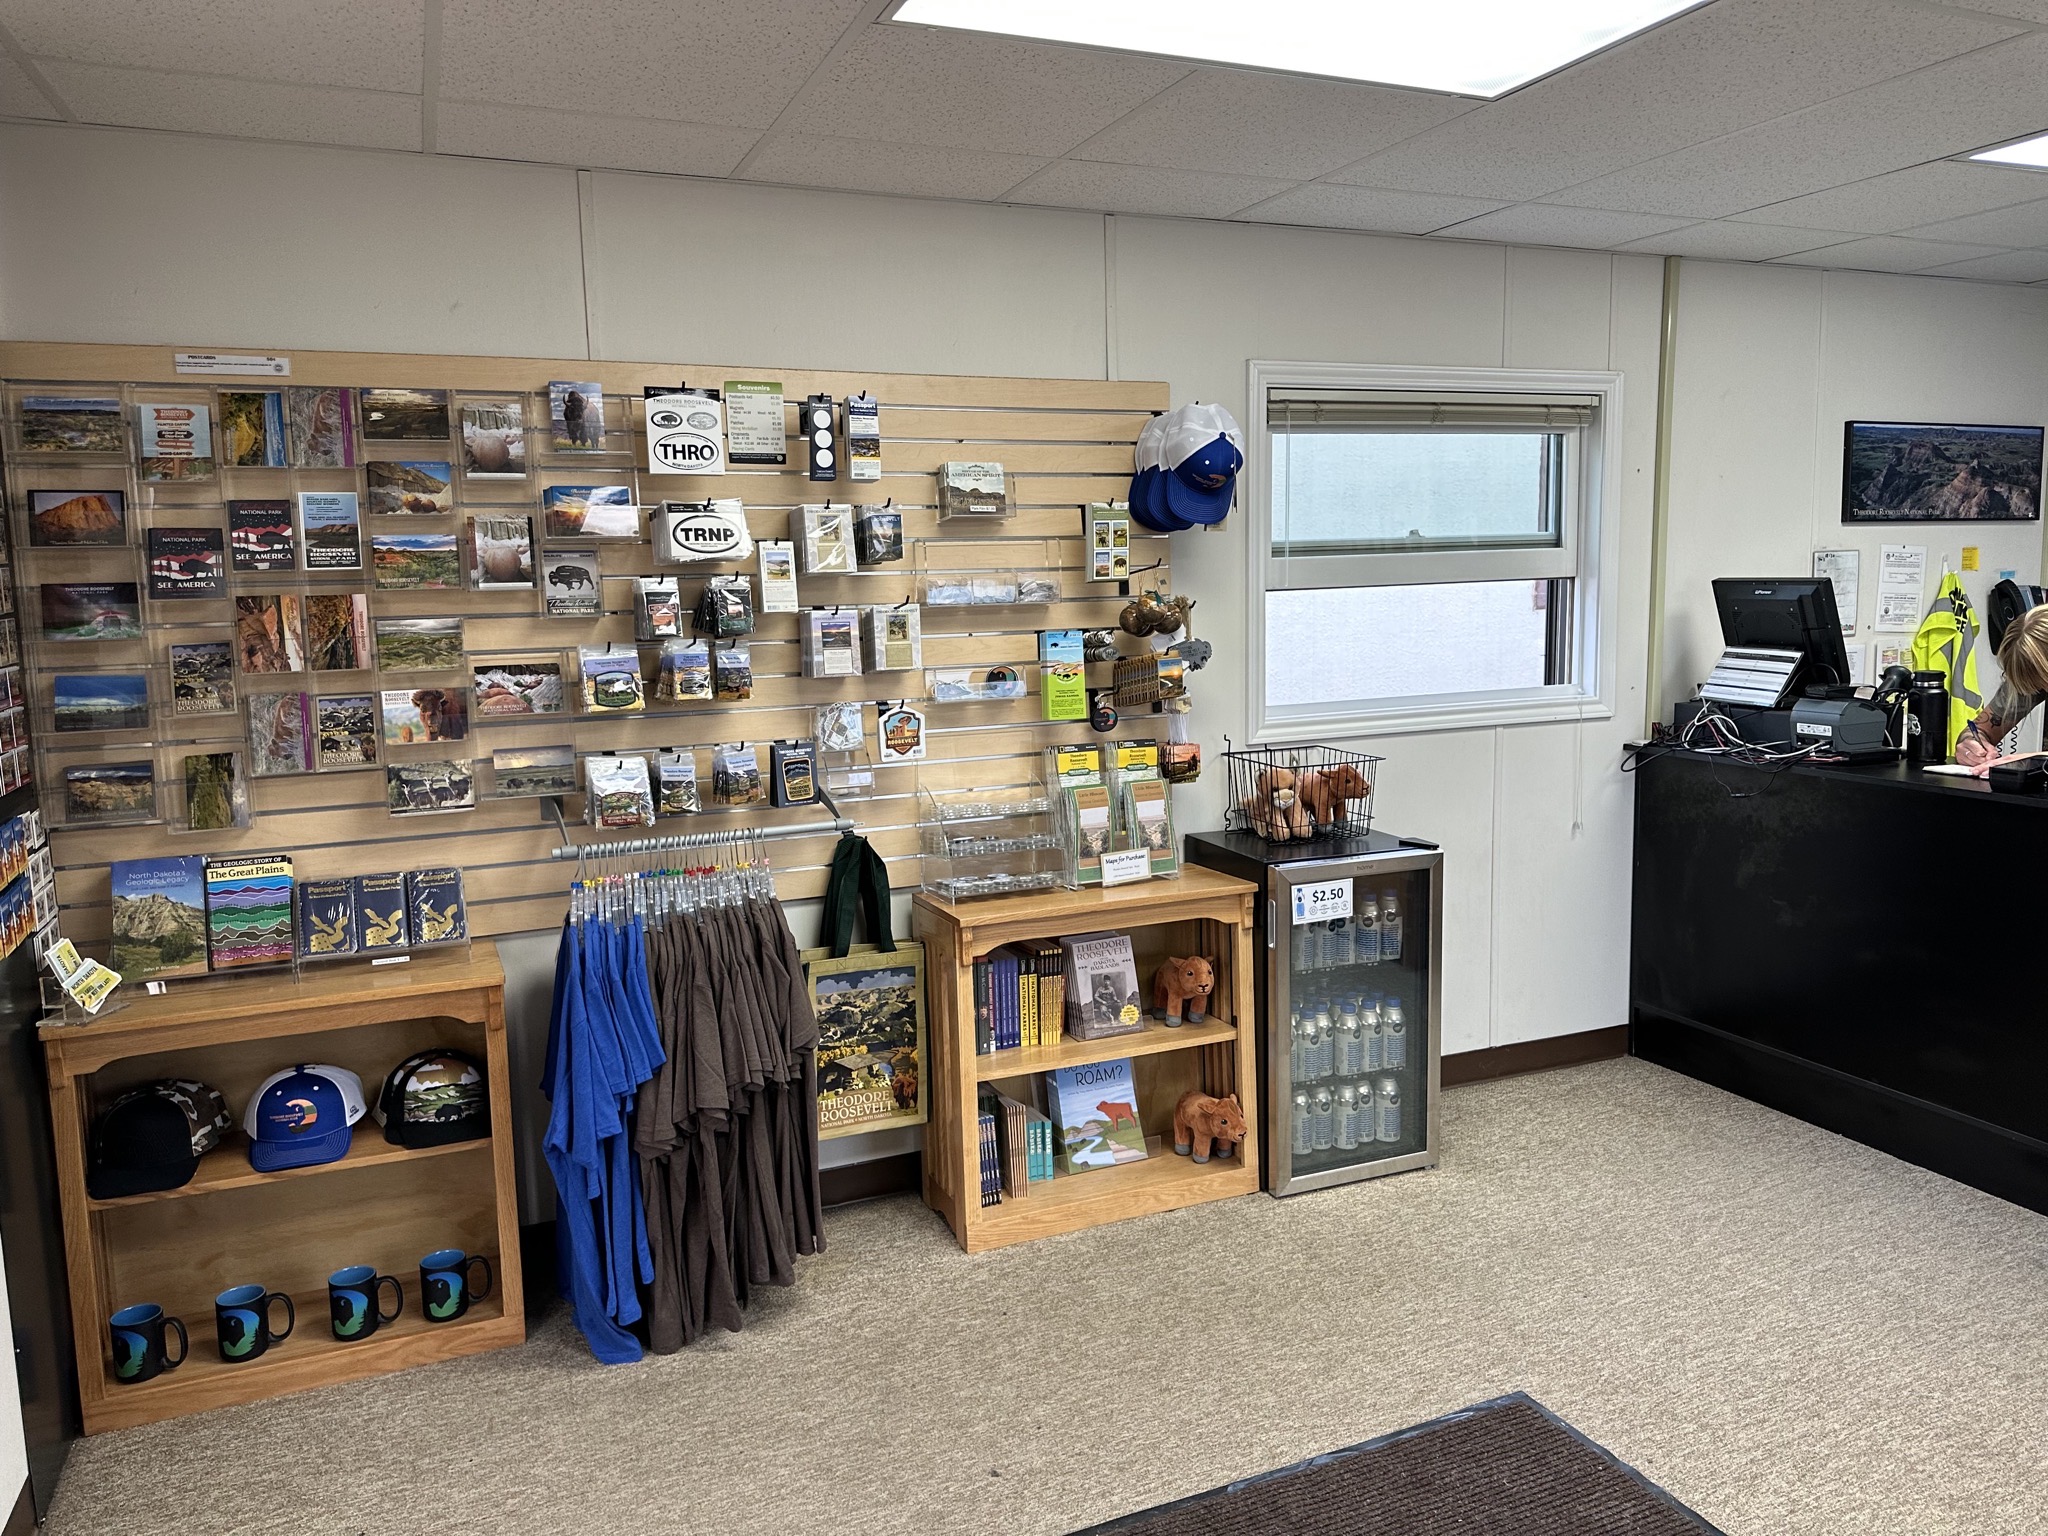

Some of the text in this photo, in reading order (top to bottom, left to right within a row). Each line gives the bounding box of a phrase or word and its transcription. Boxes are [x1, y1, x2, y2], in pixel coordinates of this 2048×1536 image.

[659, 444, 715, 461] THRO
[680, 528, 735, 541] TRNP
[177, 704, 220, 712] ROOSEVELT
[887, 737, 918, 745] ROOSEVELT
[1117, 856, 1125, 864] for
[1125, 854, 1146, 862] Purchase
[129, 870, 186, 880] North Dakota's
[209, 866, 285, 880] The Great Plains
[418, 873, 455, 882] Passport
[125, 876, 190, 887] Geologic Legacy
[362, 878, 401, 887] Passport
[307, 885, 346, 894] Passport
[1312, 887, 1344, 904] $2.50
[1075, 938, 1128, 954] THEODORE
[1076, 947, 1129, 961] ROOSEVELT
[1090, 962, 1120, 972] BADLANDS
[1093, 958, 1116, 966] DAKOTA
[71, 966, 98, 990] NORTH DAKOTA
[1075, 1065, 1123, 1087] ROAM?
[820, 1090, 890, 1111] THEODORE
[820, 1100, 894, 1123] ROOSEVELT
[857, 1114, 874, 1122] NORTH
[873, 1112, 893, 1120] DAKOTA
